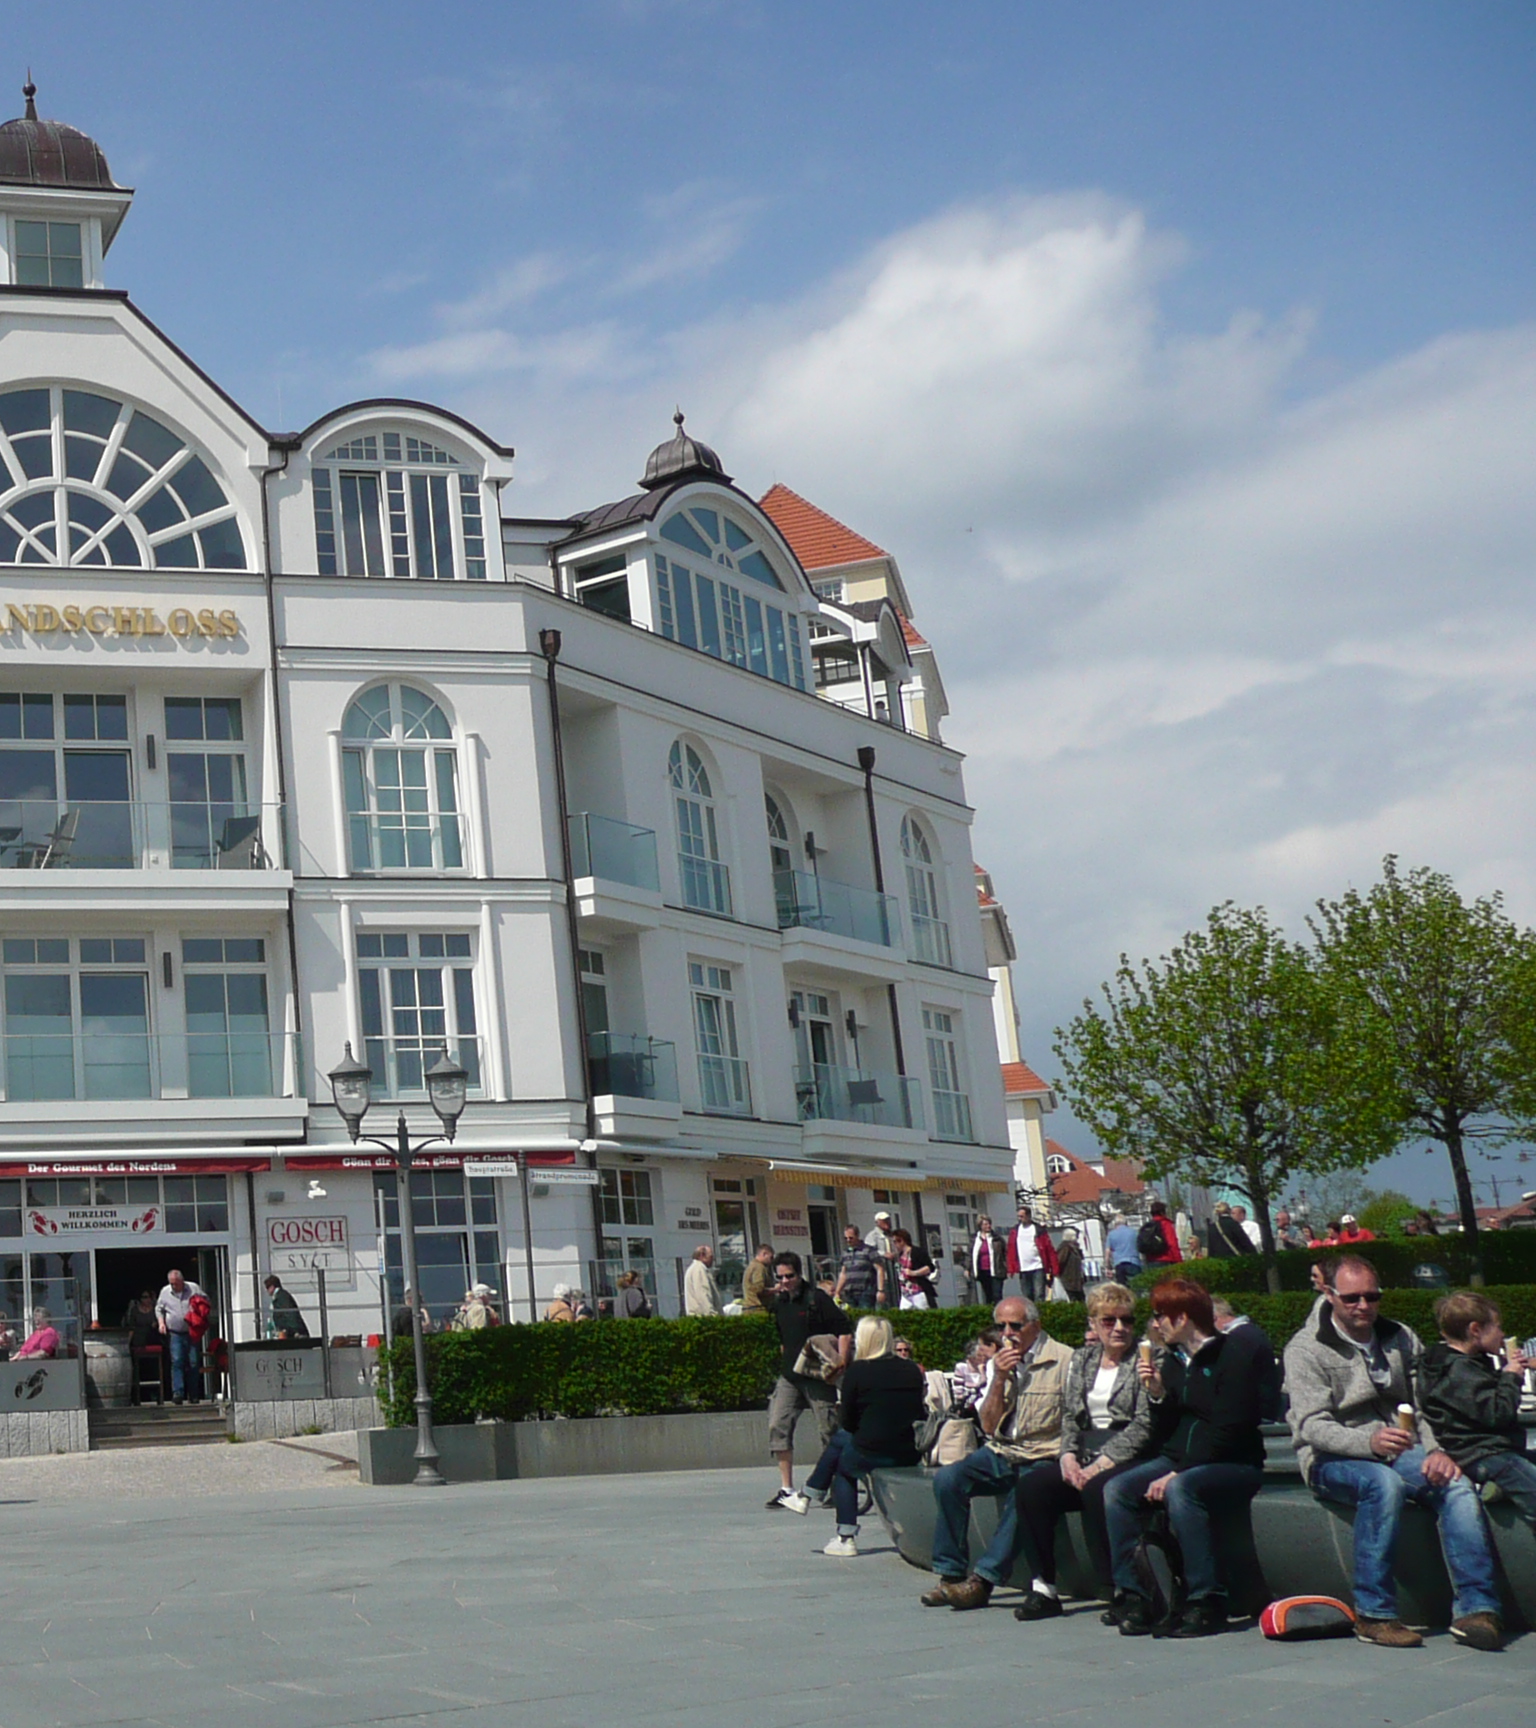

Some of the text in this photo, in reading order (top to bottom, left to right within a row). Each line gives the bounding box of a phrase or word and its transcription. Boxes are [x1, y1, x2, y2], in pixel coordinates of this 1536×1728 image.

[28, 1161, 177, 1173] Der Gourmet des Nordens
[375, 1156, 391, 1167] dir
[432, 1154, 460, 1168] gönn
[68, 1210, 117, 1219] HERZLICH
[61, 1220, 128, 1230] WILLKOMMEN
[271, 1220, 344, 1244] GOSCH
